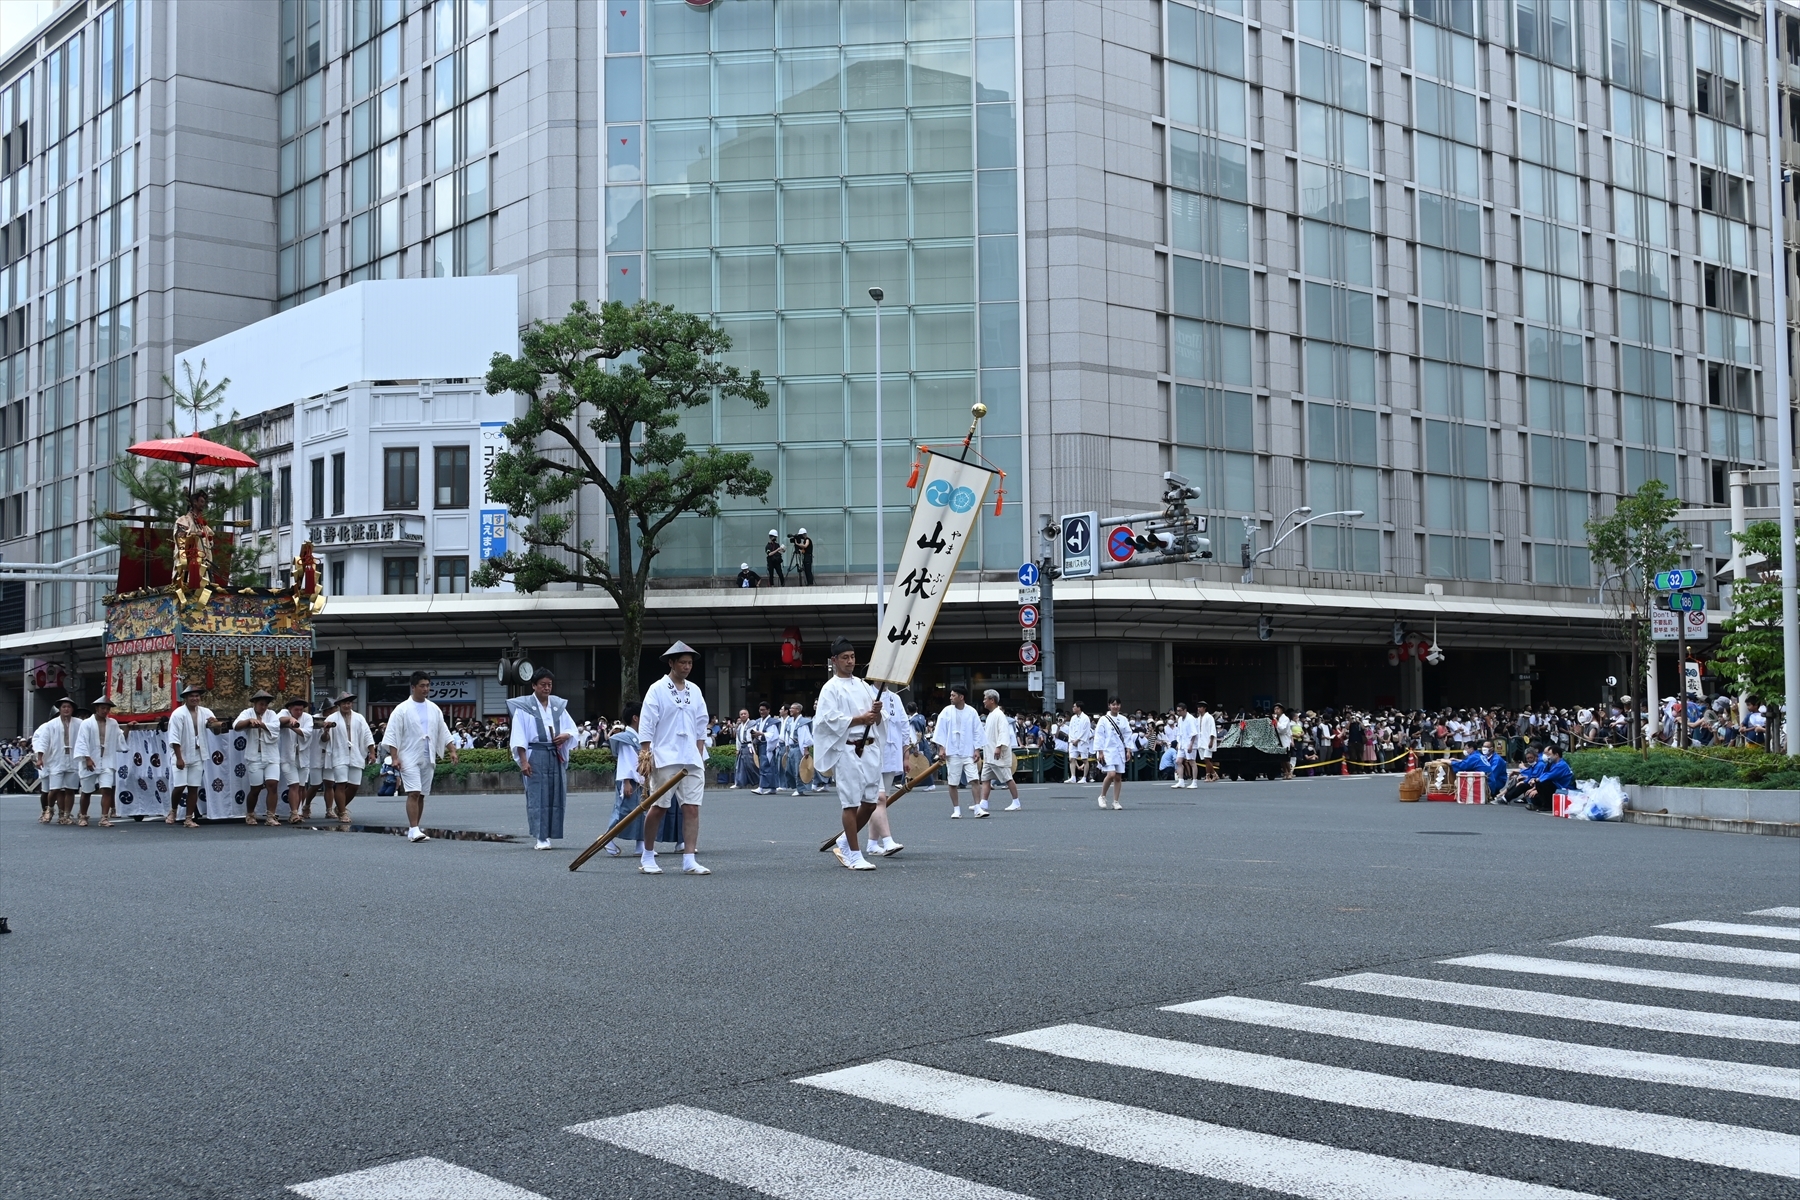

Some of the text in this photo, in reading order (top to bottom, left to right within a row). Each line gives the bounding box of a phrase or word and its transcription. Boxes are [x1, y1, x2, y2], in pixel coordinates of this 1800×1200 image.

[309, 521, 395, 544] 池善化粧品店
[482, 513, 493, 558] 買えます
[494, 514, 504, 537] すぐ
[945, 530, 962, 555] やま
[887, 520, 946, 646] 山伏山
[1670, 574, 1680, 586] 32
[1681, 596, 1692, 607] 186
[911, 620, 926, 645] やま
[427, 688, 468, 699] ンタクト
